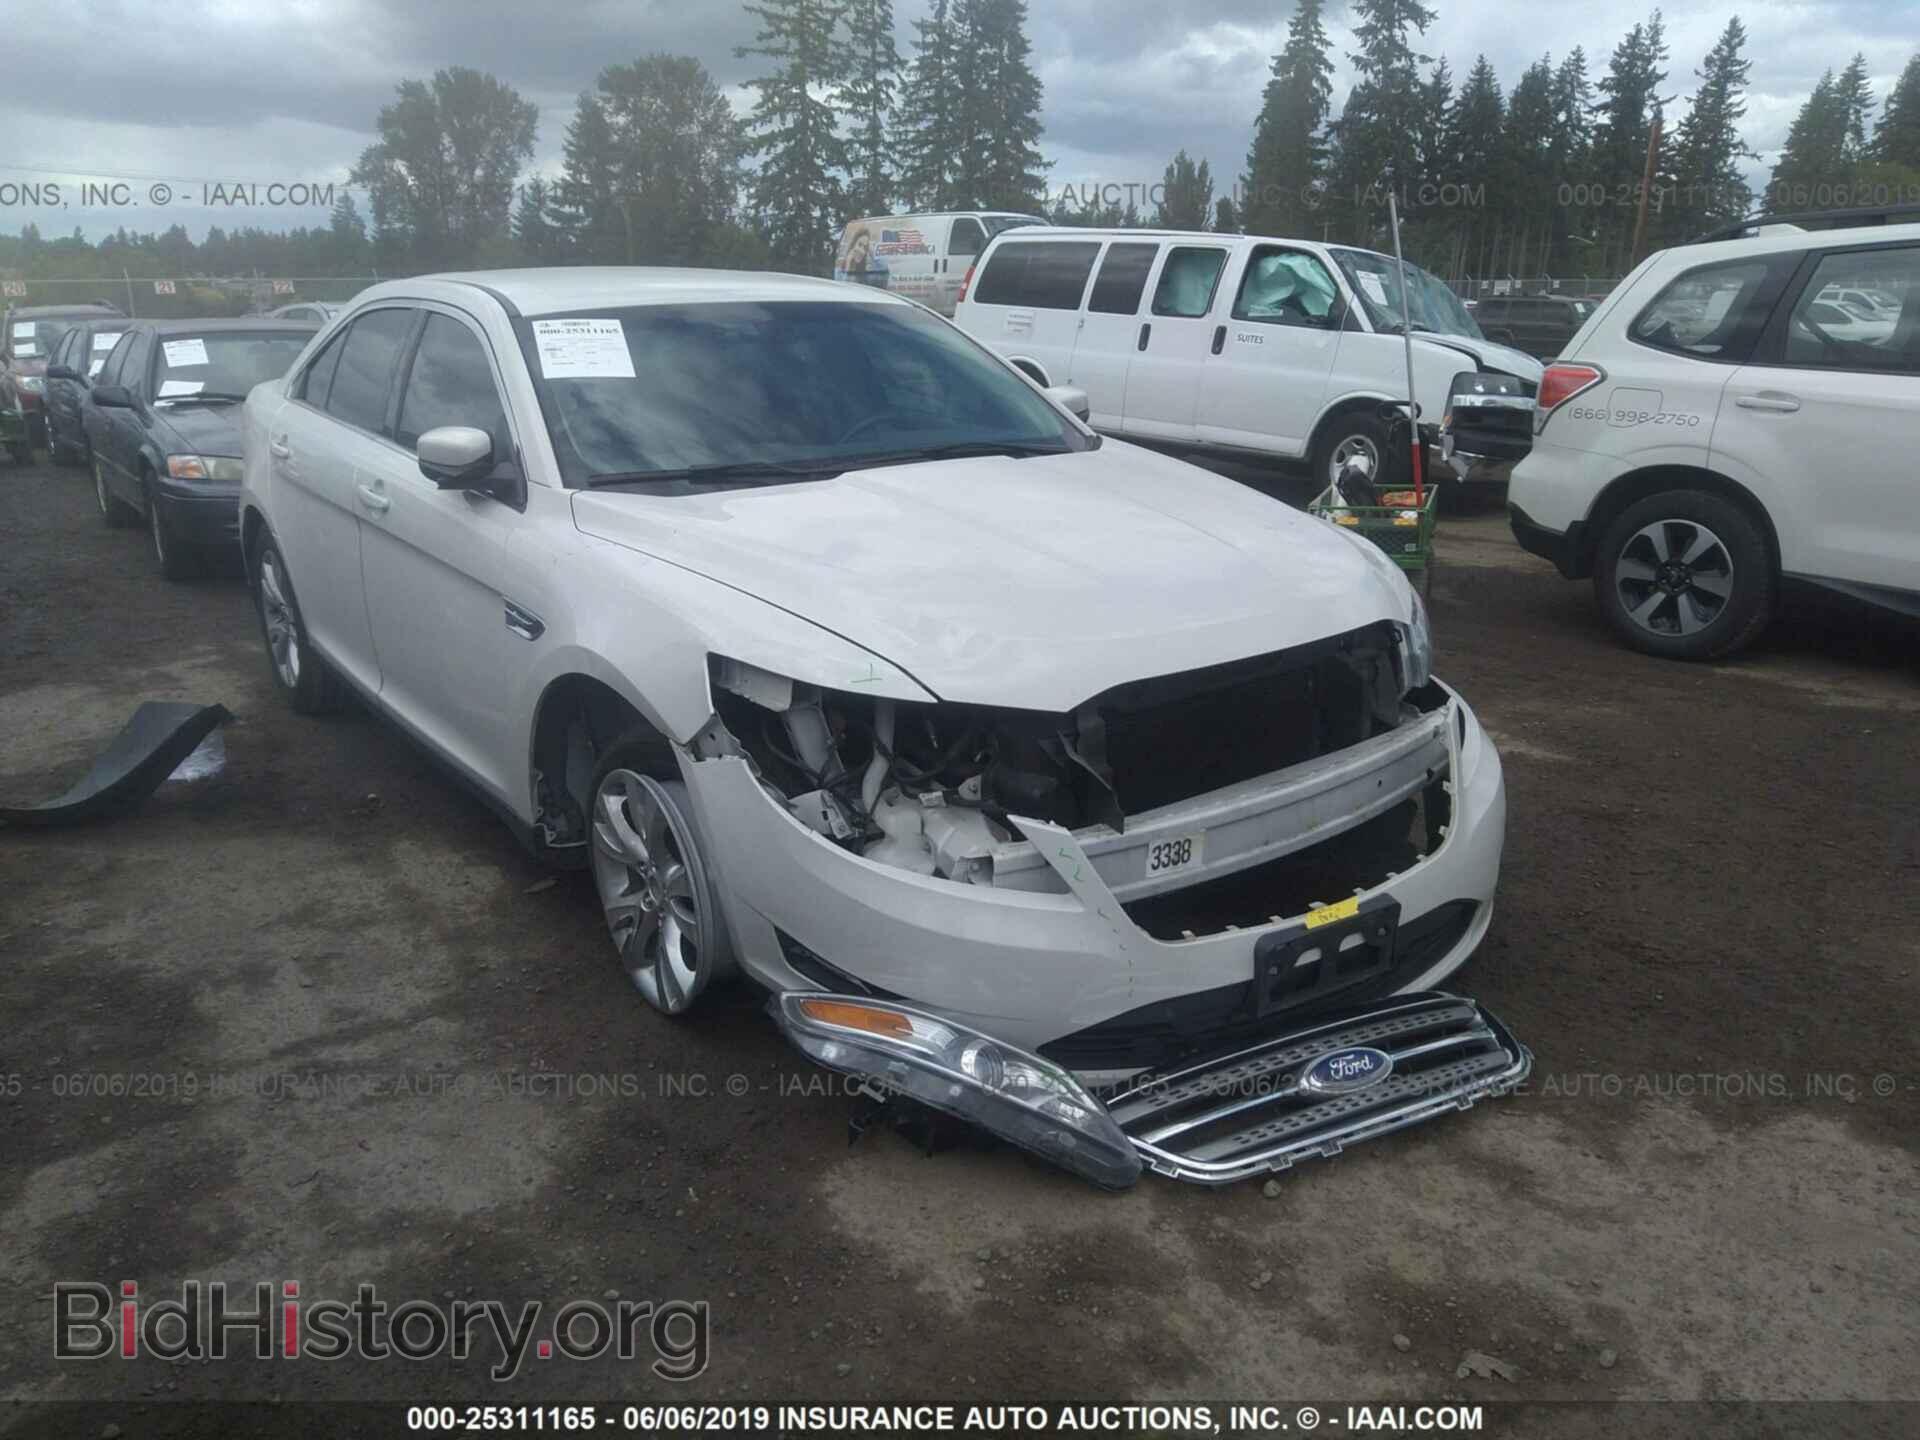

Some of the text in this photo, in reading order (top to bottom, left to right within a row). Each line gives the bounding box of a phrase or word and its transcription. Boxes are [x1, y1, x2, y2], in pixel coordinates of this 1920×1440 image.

[1237, 333, 1264, 345] SUITES
[1568, 406, 1700, 427] (866) 998-2750
[1151, 838, 1192, 871] 3338
[1329, 1053, 1374, 1080] Ford
